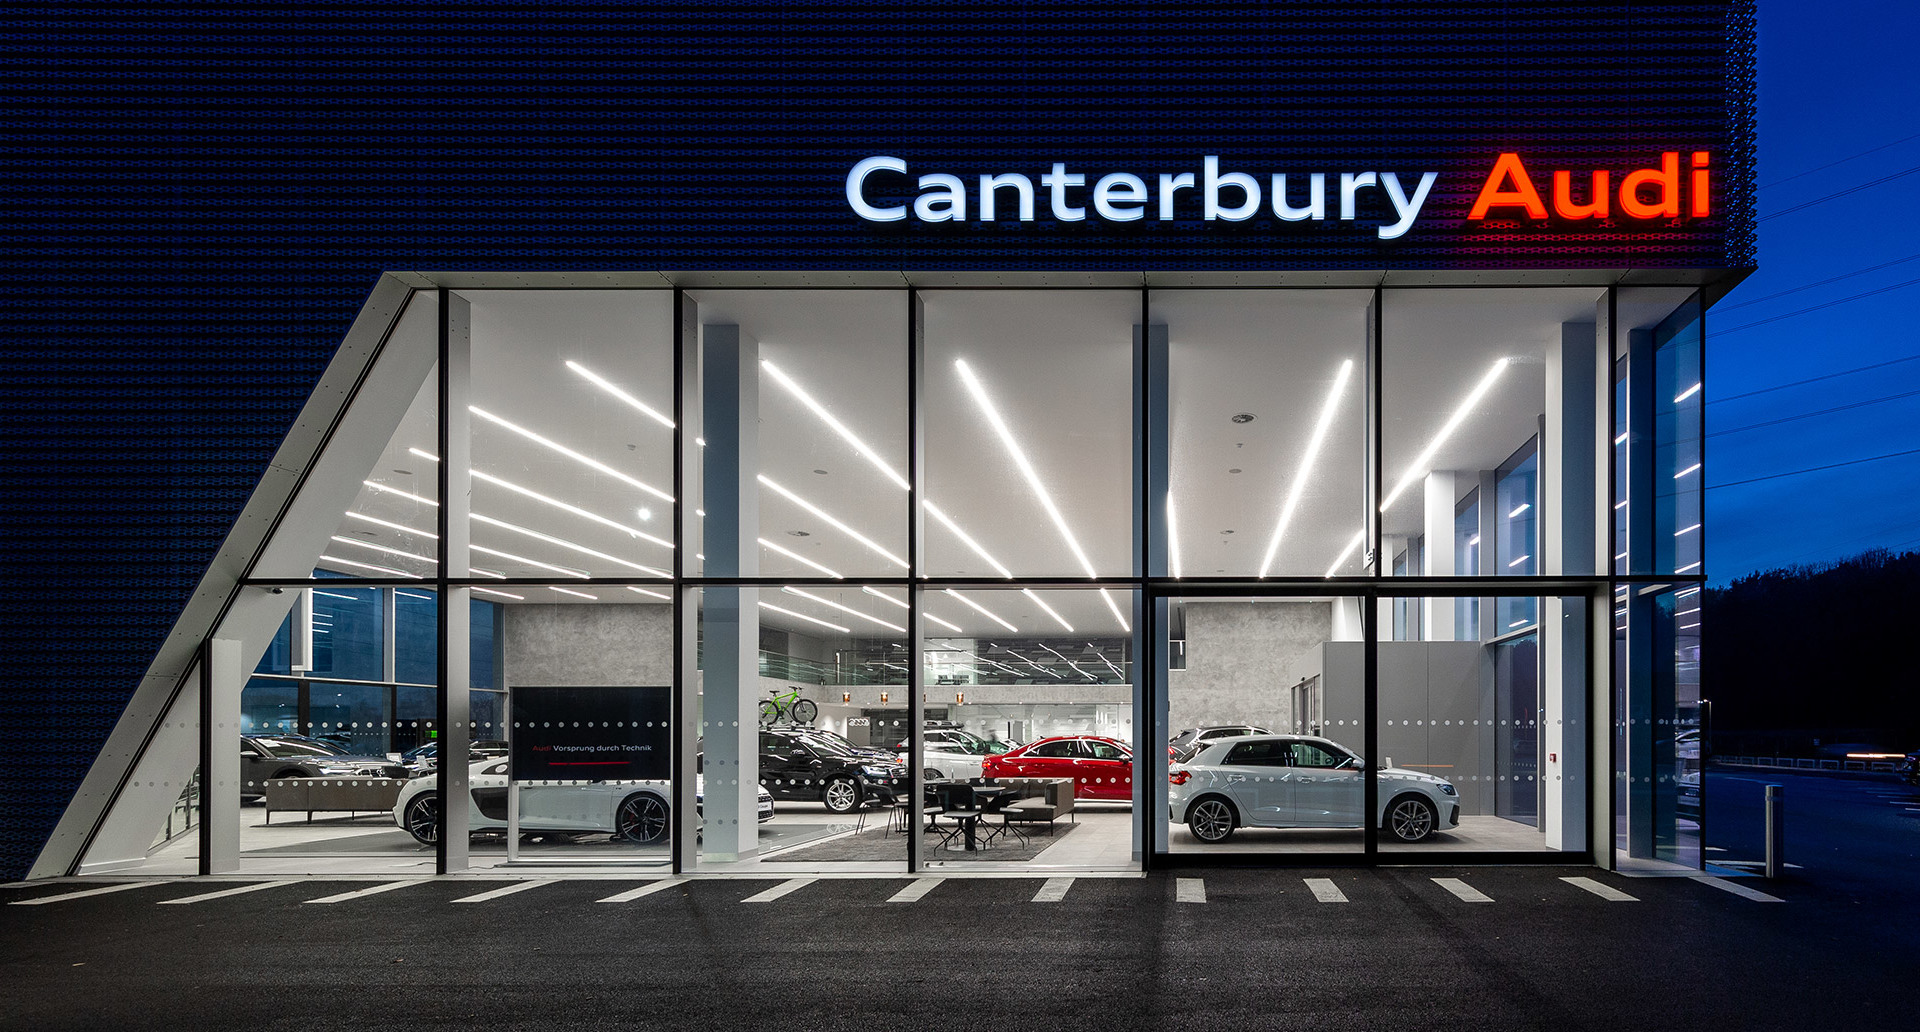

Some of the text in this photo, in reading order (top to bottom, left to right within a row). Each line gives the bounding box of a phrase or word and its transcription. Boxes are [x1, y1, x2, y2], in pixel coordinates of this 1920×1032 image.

[845, 152, 1712, 240] Canterbury Audi
[553, 745, 595, 753] Vorsprung
[621, 744, 652, 752] Technik
